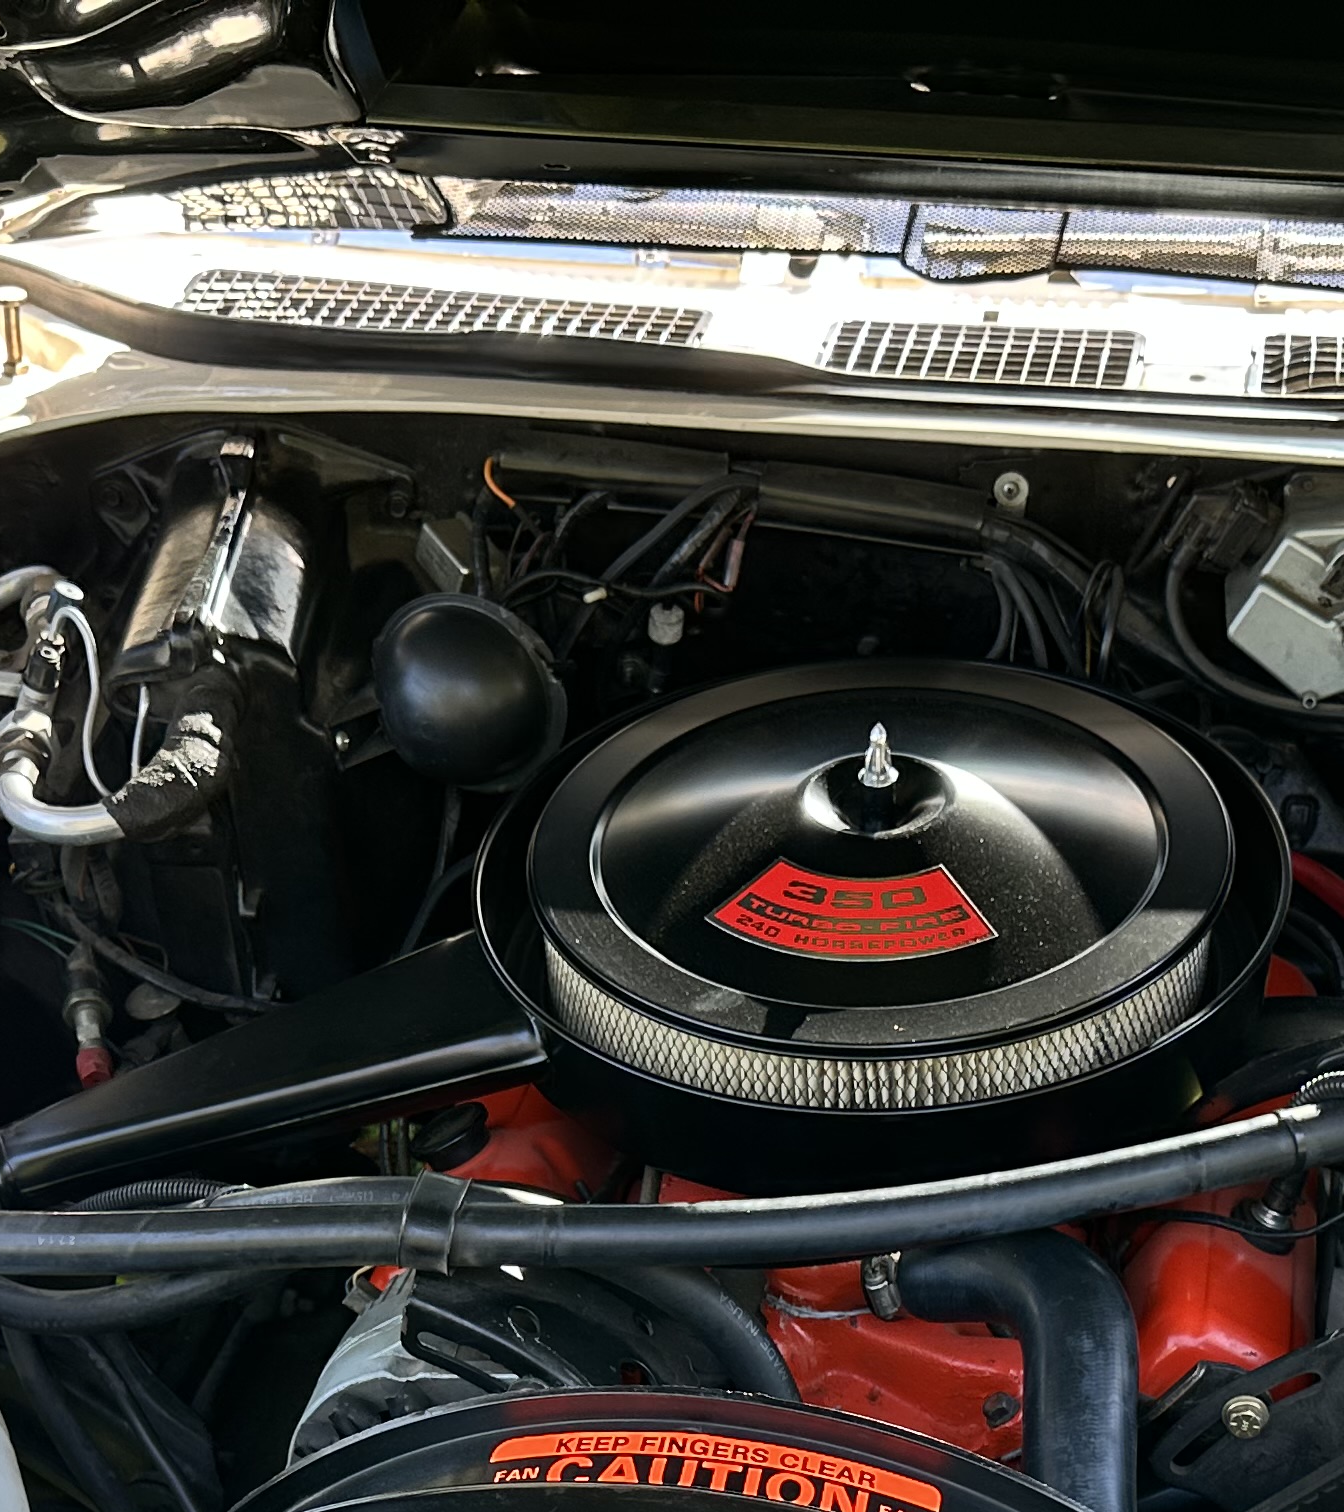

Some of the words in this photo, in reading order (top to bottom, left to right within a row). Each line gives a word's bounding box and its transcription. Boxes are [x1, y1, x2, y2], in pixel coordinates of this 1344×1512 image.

[783, 880, 927, 910] 350
[736, 914, 781, 938] 240
[494, 1466, 539, 1484] FAN
[556, 1436, 630, 1454] KEEP
[640, 1436, 769, 1464] FINGERS
[779, 1453, 876, 1490] CLEAR
